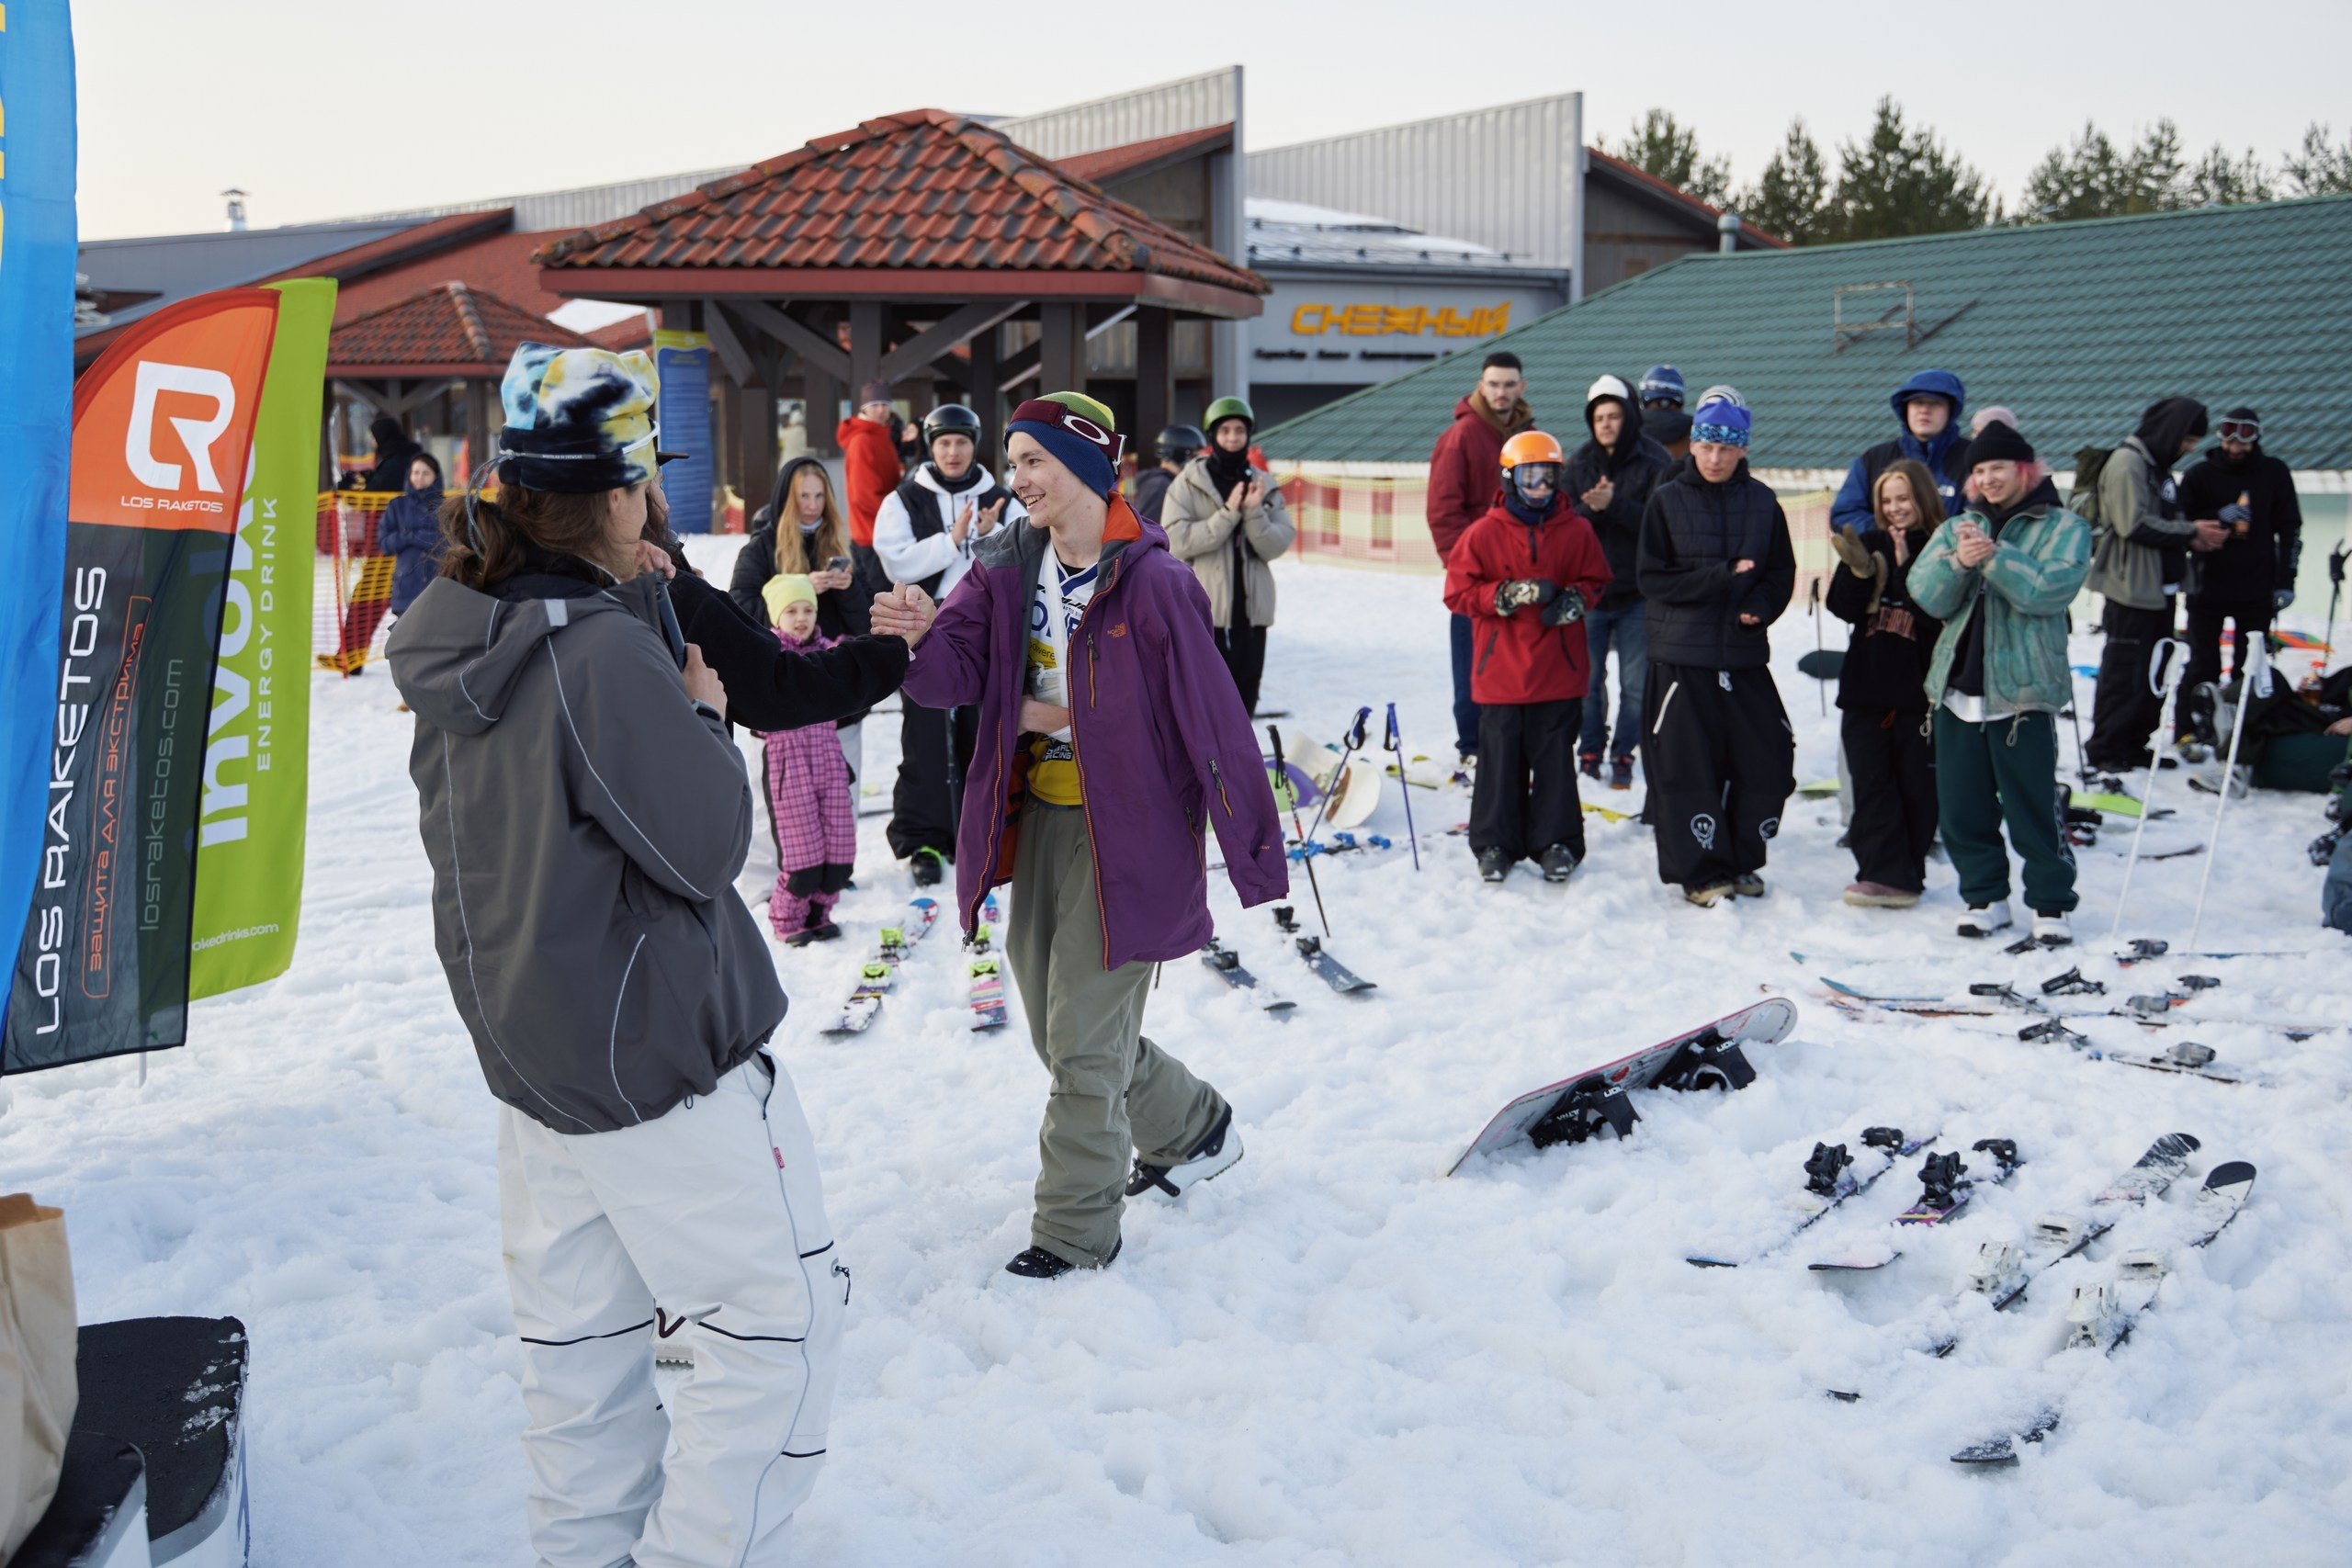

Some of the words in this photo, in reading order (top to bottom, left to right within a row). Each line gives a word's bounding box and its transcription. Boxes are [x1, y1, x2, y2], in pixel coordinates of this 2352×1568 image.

[1291, 301, 1511, 336] СНЕЖНЫЙ
[120, 495, 154, 509] LOS
[157, 499, 224, 513] RAKETOS
[260, 498, 277, 612] DRINK
[256, 624, 273, 772] ENERGY
[1029, 641, 1056, 660] owere
[44, 567, 107, 889] RAKETOS
[139, 659, 184, 931] losraketos.com
[35, 905, 63, 1035] LOS
[191, 923, 279, 952] okedrinks.com
